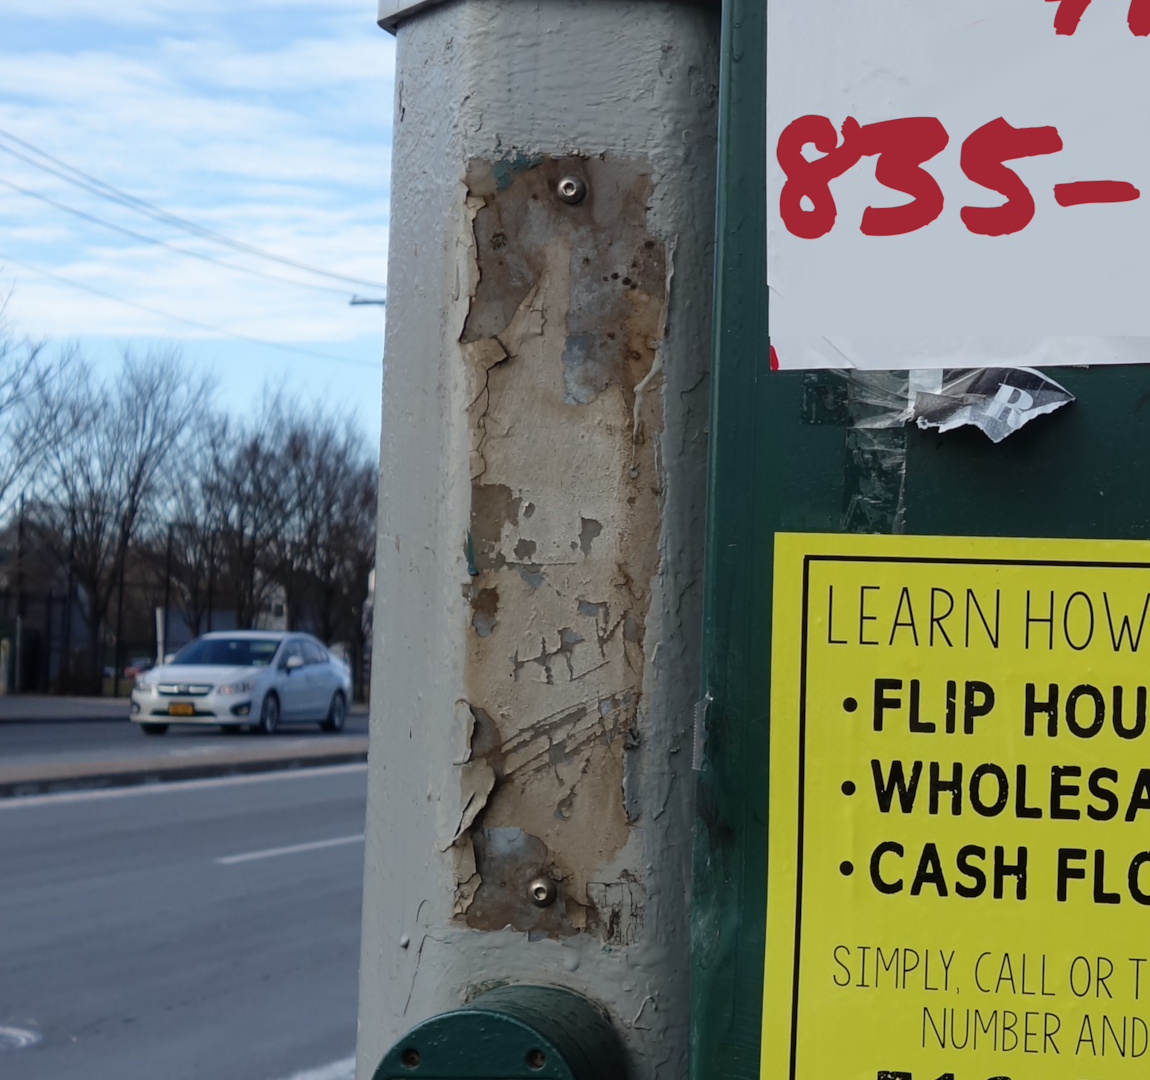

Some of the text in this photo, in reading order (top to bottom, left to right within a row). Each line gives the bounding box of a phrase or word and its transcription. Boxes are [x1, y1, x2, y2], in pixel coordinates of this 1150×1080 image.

[828, 585, 1000, 648] LEARN
[1025, 590, 1150, 652] HOW
[871, 679, 995, 734] FLIP
[869, 841, 1027, 900] CASH
[832, 945, 962, 996] SIMPLY,
[974, 952, 1056, 997] CALL
[1069, 956, 1114, 1000] OR
[921, 1006, 1061, 1055] NUMBER
[1075, 1014, 1150, 1058] AND
